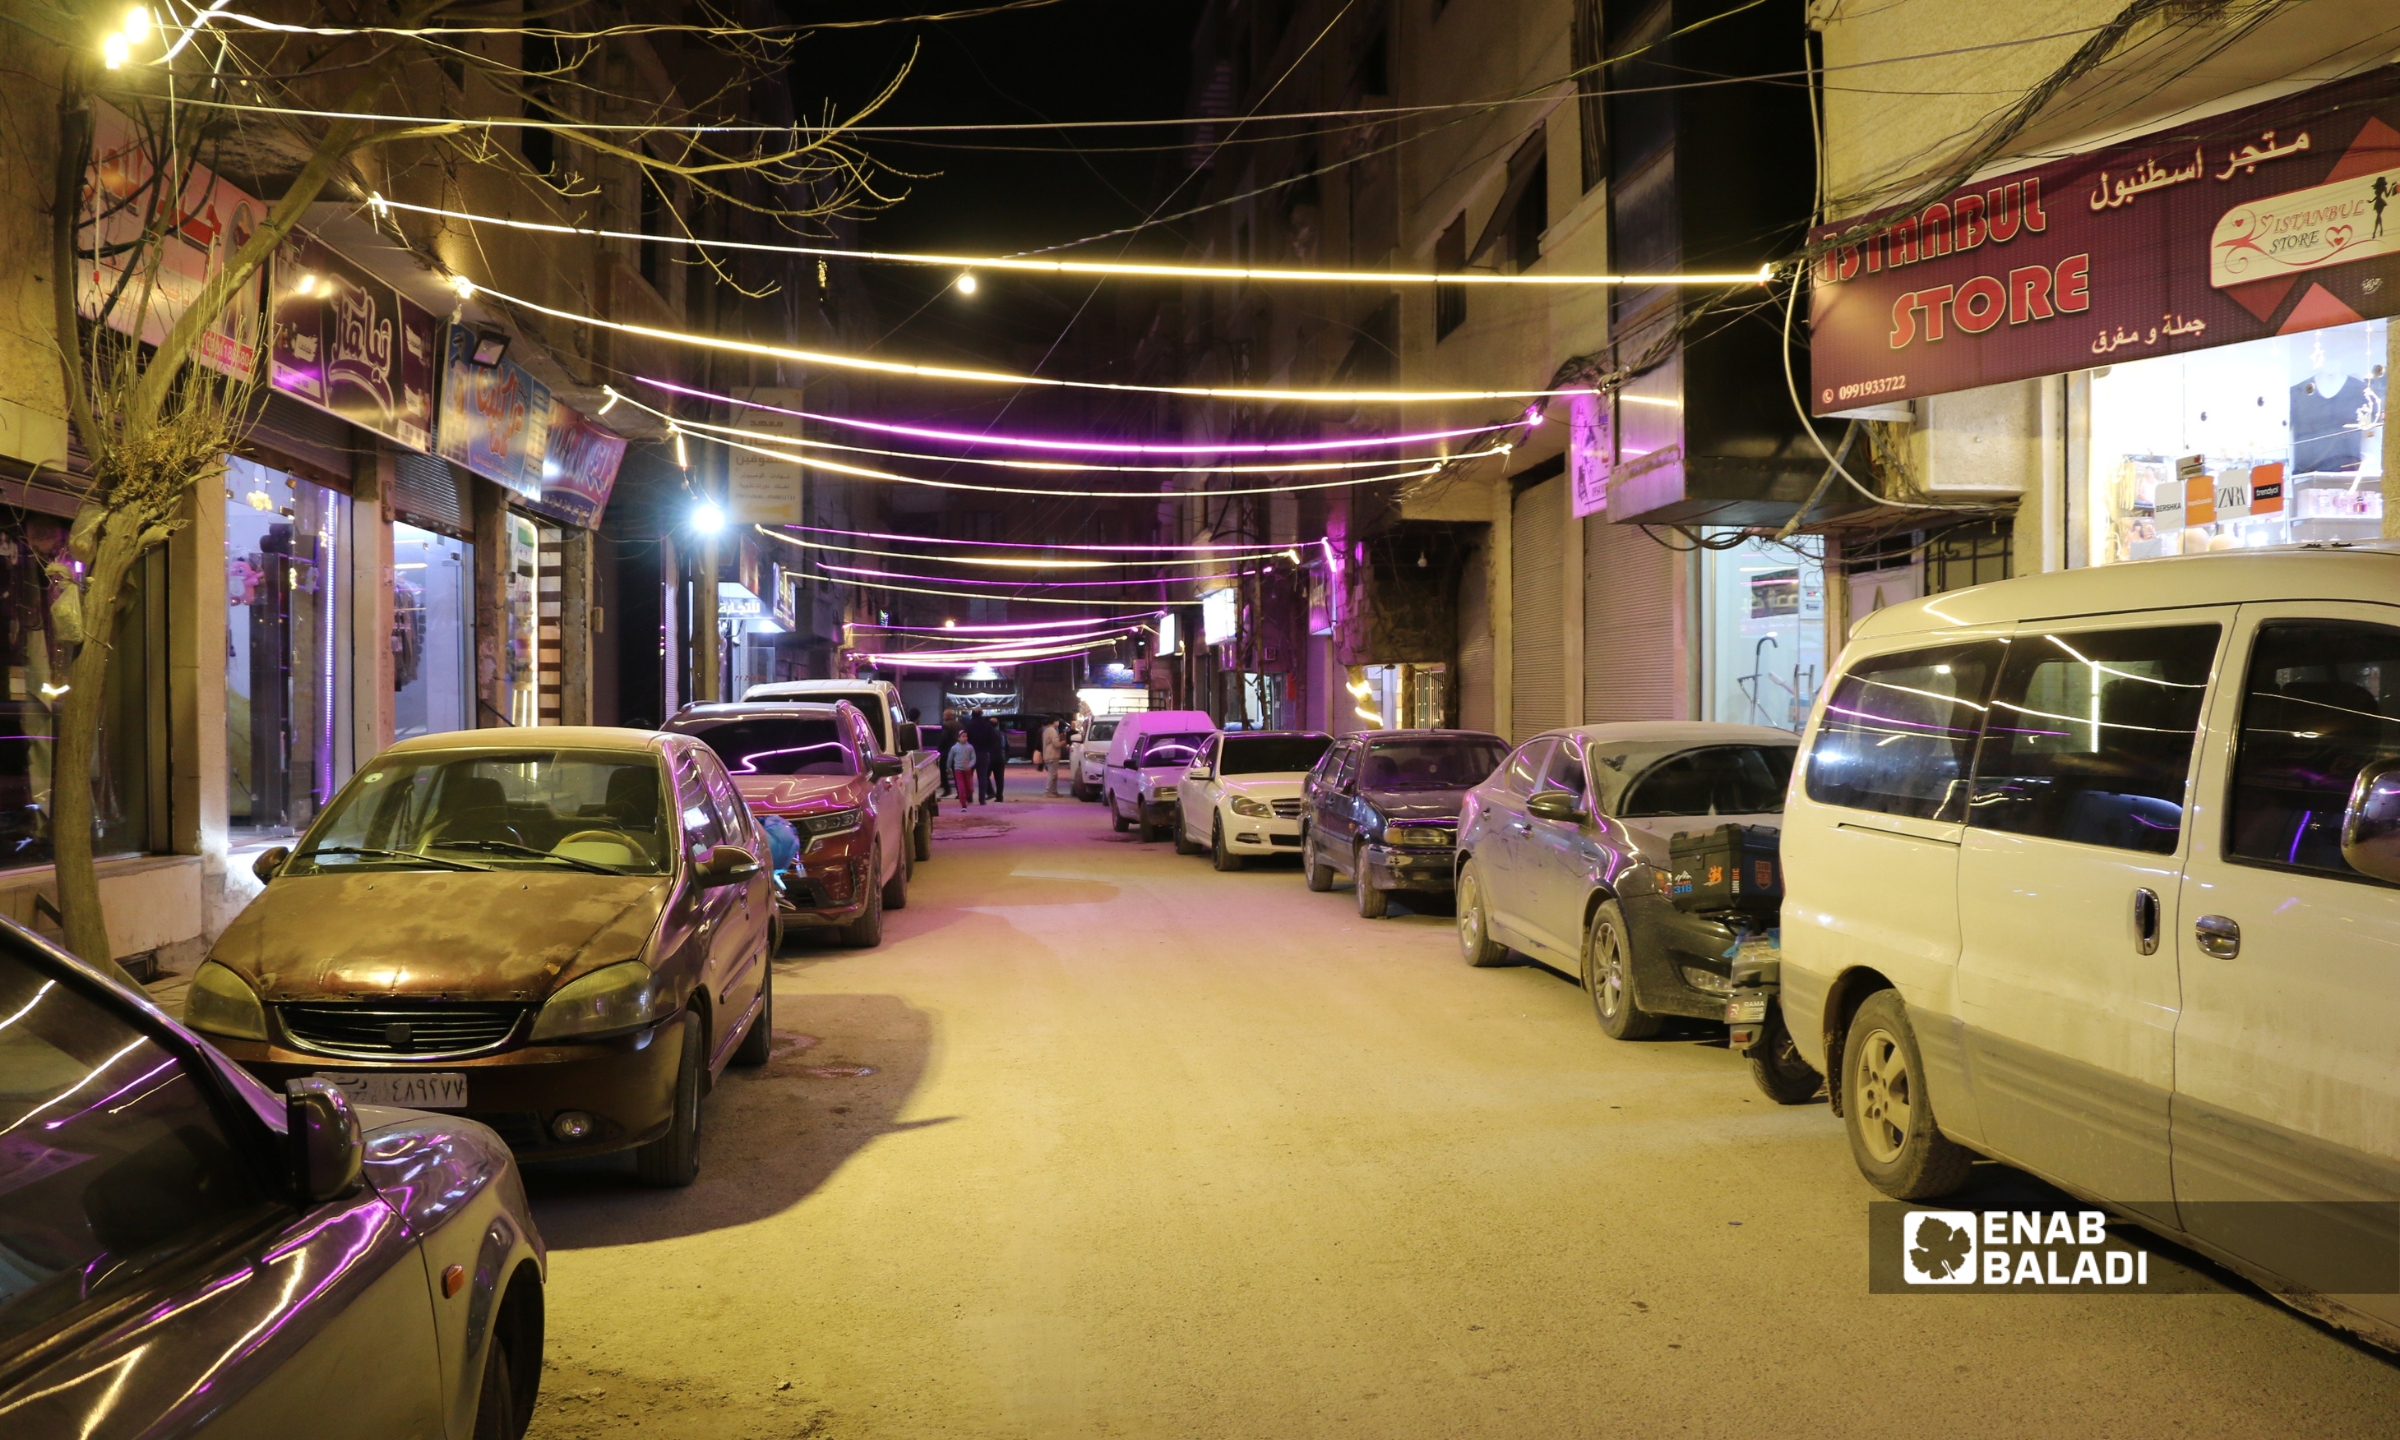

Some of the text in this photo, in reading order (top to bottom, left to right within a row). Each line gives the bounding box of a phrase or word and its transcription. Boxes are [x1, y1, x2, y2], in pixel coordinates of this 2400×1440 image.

[2089, 128, 2311, 212] متجر اسطنبول
[2273, 199, 2365, 234] ISTANBUL
[1822, 176, 2046, 285] ISTANBUL
[2269, 230, 2319, 254] STORE
[1890, 253, 2089, 349] STORE
[2091, 314, 2206, 353] جملة و مفرق
[1839, 375, 1906, 400] 0991933722
[750, 419, 784, 428] معهد
[2218, 485, 2246, 509] ZARA
[2255, 486, 2279, 498] trendyol
[2155, 502, 2182, 513] BERSHKA
[1673, 883, 1693, 895] 318
